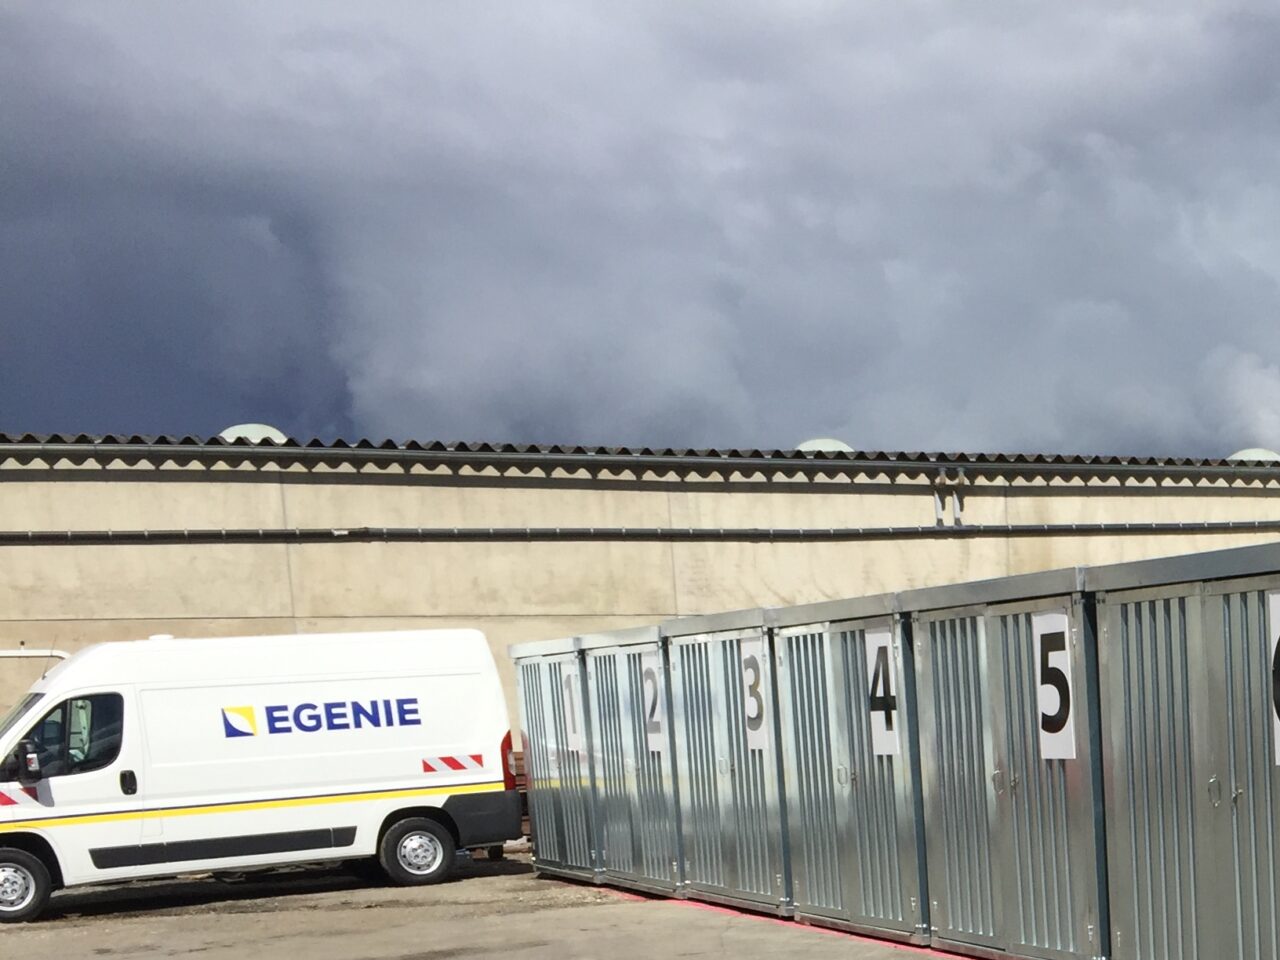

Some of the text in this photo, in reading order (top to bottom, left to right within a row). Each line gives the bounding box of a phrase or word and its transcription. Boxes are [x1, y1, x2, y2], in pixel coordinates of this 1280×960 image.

[265, 698, 421, 734] EGENIE
[564, 673, 577, 735] 1
[643, 666, 661, 734] 2
[743, 655, 764, 731] 3
[869, 646, 897, 731] 4
[1040, 631, 1071, 734] 5
